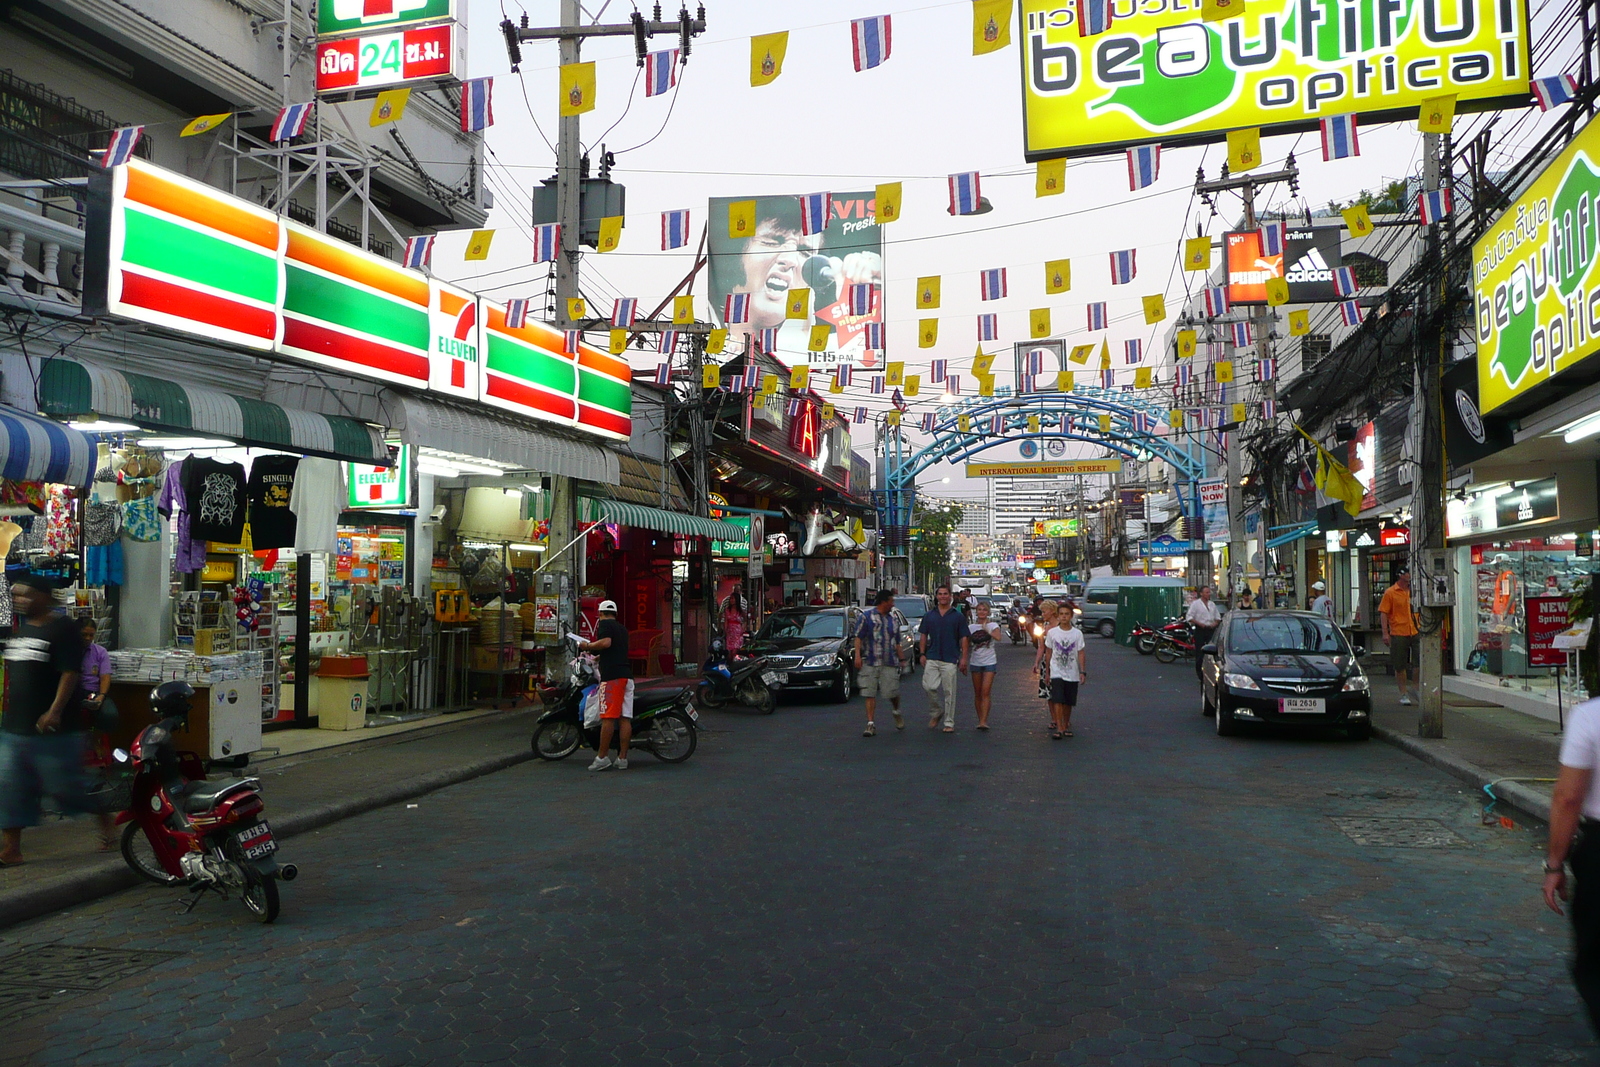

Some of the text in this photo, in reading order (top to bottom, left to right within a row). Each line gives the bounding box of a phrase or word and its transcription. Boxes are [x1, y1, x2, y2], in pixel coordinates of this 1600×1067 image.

[320, 49, 354, 75] เปิด
[361, 39, 401, 77] 24
[1259, 40, 1516, 110] optical
[842, 214, 881, 236] Presle
[1477, 194, 1600, 341] beautif
[1285, 269, 1333, 283] adidas
[807, 351, 836, 363] 11:15
[980, 467, 1038, 476] INTERNATIONAL
[1041, 465, 1075, 475] MEETING
[1077, 464, 1107, 472] STREET
[262, 474, 294, 483] SINGHA
[1200, 484, 1224, 493] OPEN
[1202, 493, 1224, 502] NOW
[213, 565, 226, 573] ATM
[1539, 601, 1569, 613] NEW
